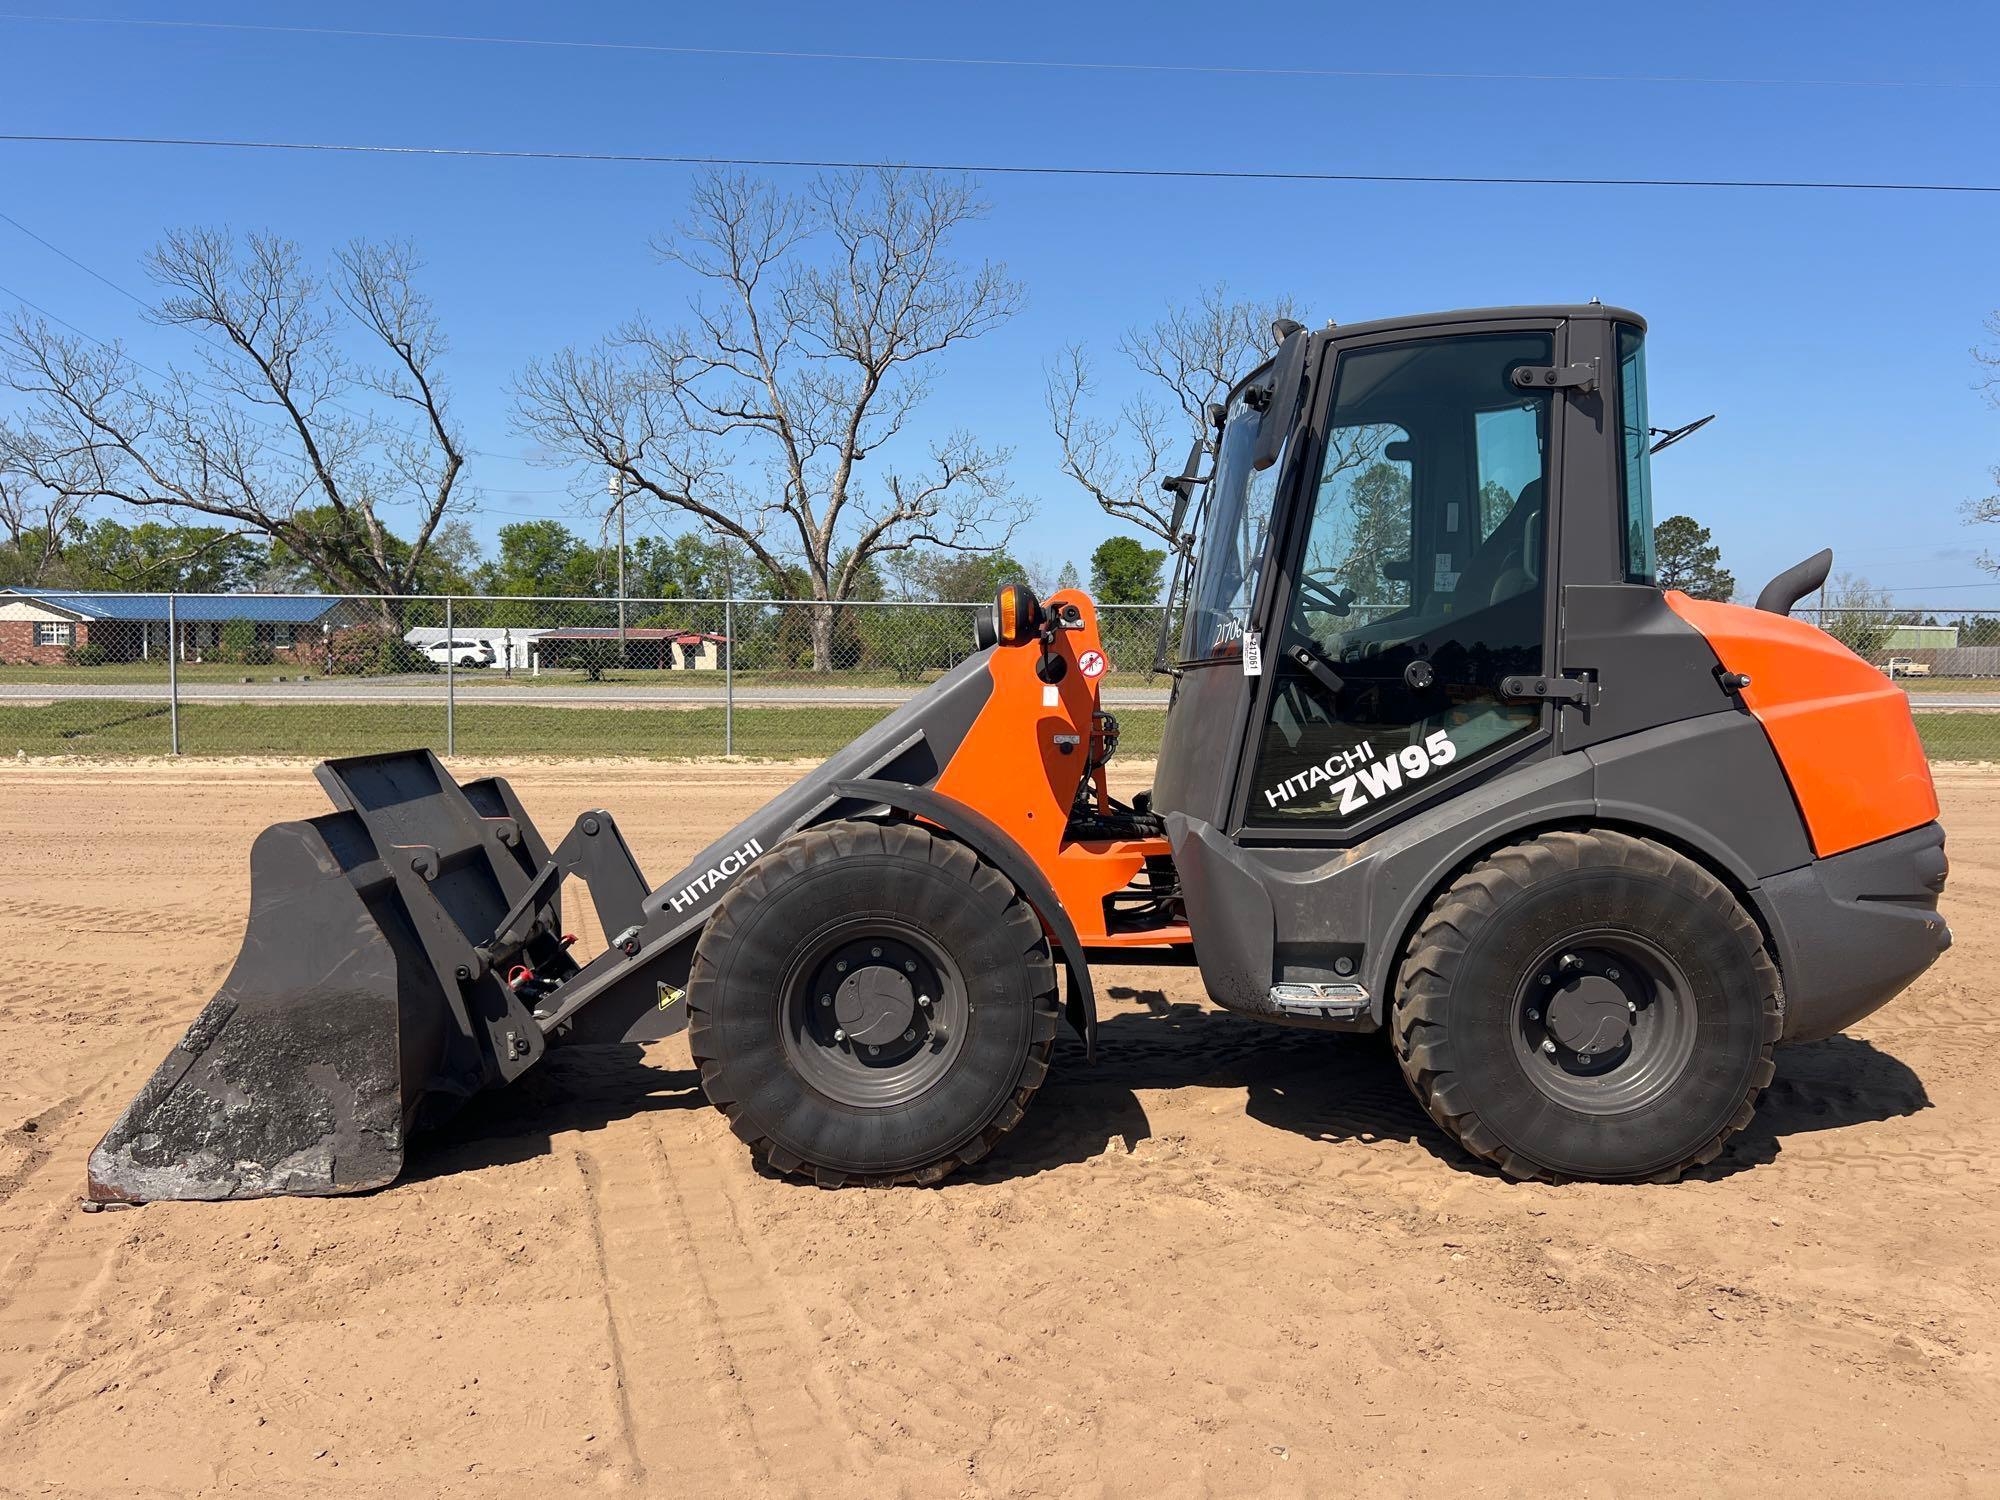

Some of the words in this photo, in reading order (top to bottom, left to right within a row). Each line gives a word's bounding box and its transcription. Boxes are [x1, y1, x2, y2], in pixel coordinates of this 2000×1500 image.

[1249, 641, 1258, 669] 217061
[1264, 740, 1375, 808] HITACHI
[1329, 728, 1457, 816] ZW95
[669, 838, 764, 913] HITACHI
